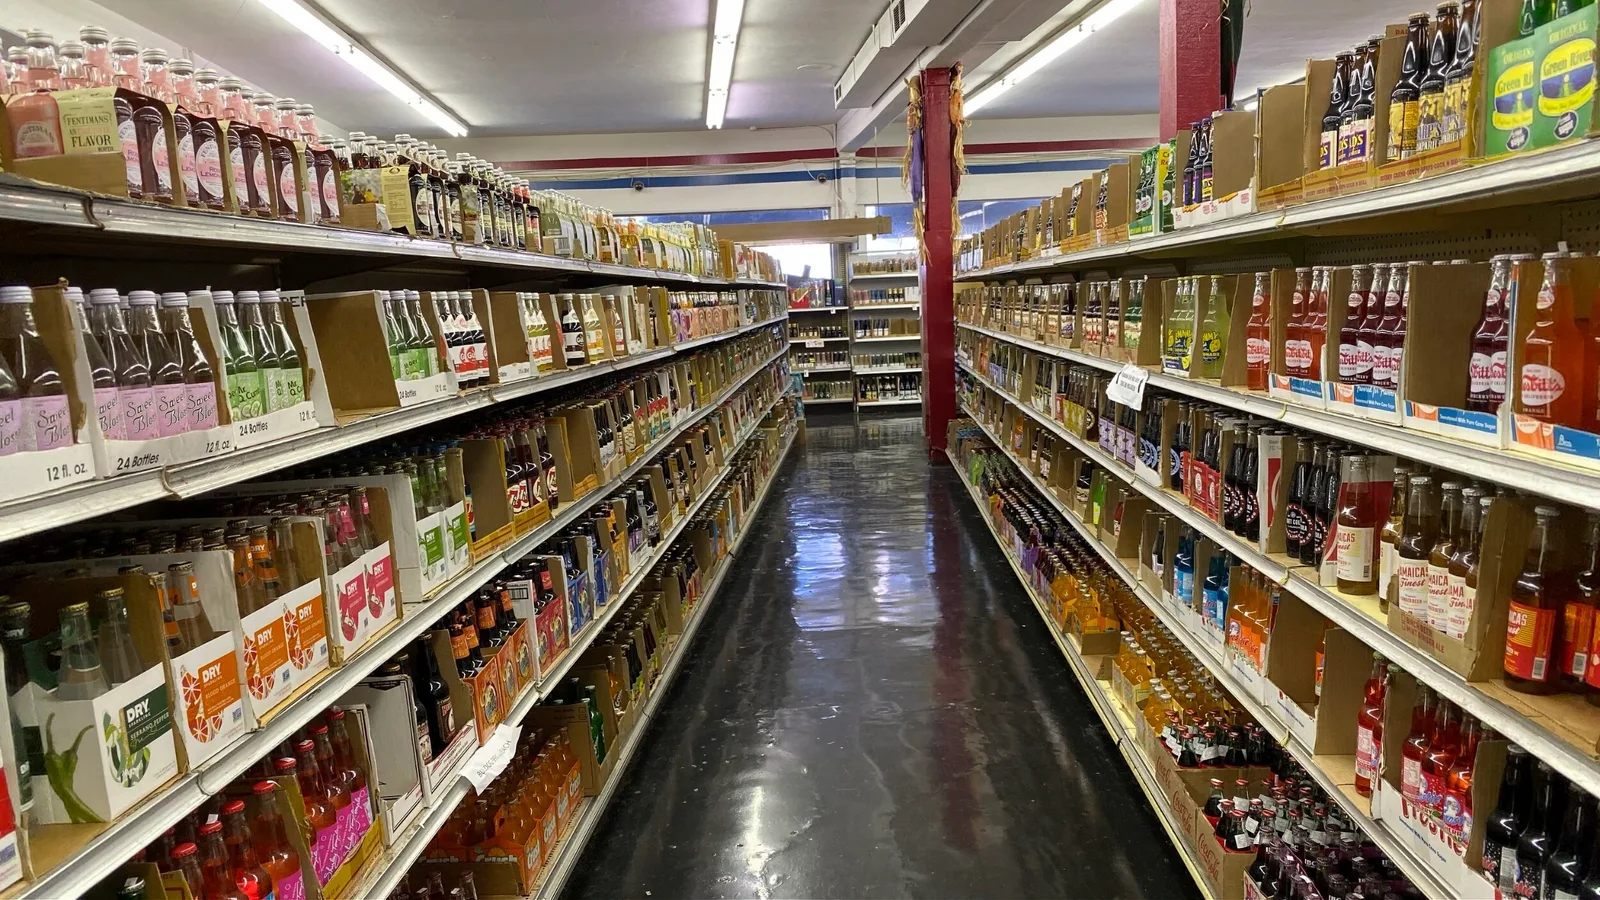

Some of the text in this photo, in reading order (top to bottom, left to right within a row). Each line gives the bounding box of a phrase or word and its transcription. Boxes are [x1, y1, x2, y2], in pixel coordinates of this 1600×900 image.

[1544, 58, 1568, 76] Green
[1498, 78, 1521, 94] Green
[67, 116, 108, 126] FENTIMANS
[72, 136, 112, 148] FLAVOR
[240, 421, 269, 436] 24 Bottles
[1440, 414, 1458, 422] Sweetened
[1484, 422, 1496, 430] Sugar
[205, 441, 214, 453] 12
[116, 452, 159, 471] 24 Bottles
[47, 463, 88, 481] 12 fl. oz.
[374, 562, 384, 576] DRY
[346, 581, 358, 596] DRY
[298, 604, 312, 621] DRY
[258, 628, 273, 646] DRY
[202, 662, 221, 683] DRY
[205, 678, 236, 700] BLOOD ORANGE
[126, 698, 150, 723] DRY
[130, 712, 170, 740] SERRANO PEPPER
[1198, 833, 1220, 882] Coca-Cola
[1329, 850, 1336, 859] 4
[1421, 837, 1429, 846] Pure
[1437, 852, 1447, 863] Sugar
[324, 852, 339, 879] Shirley
[1304, 858, 1317, 868] IBC
[1354, 885, 1362, 894] 4
